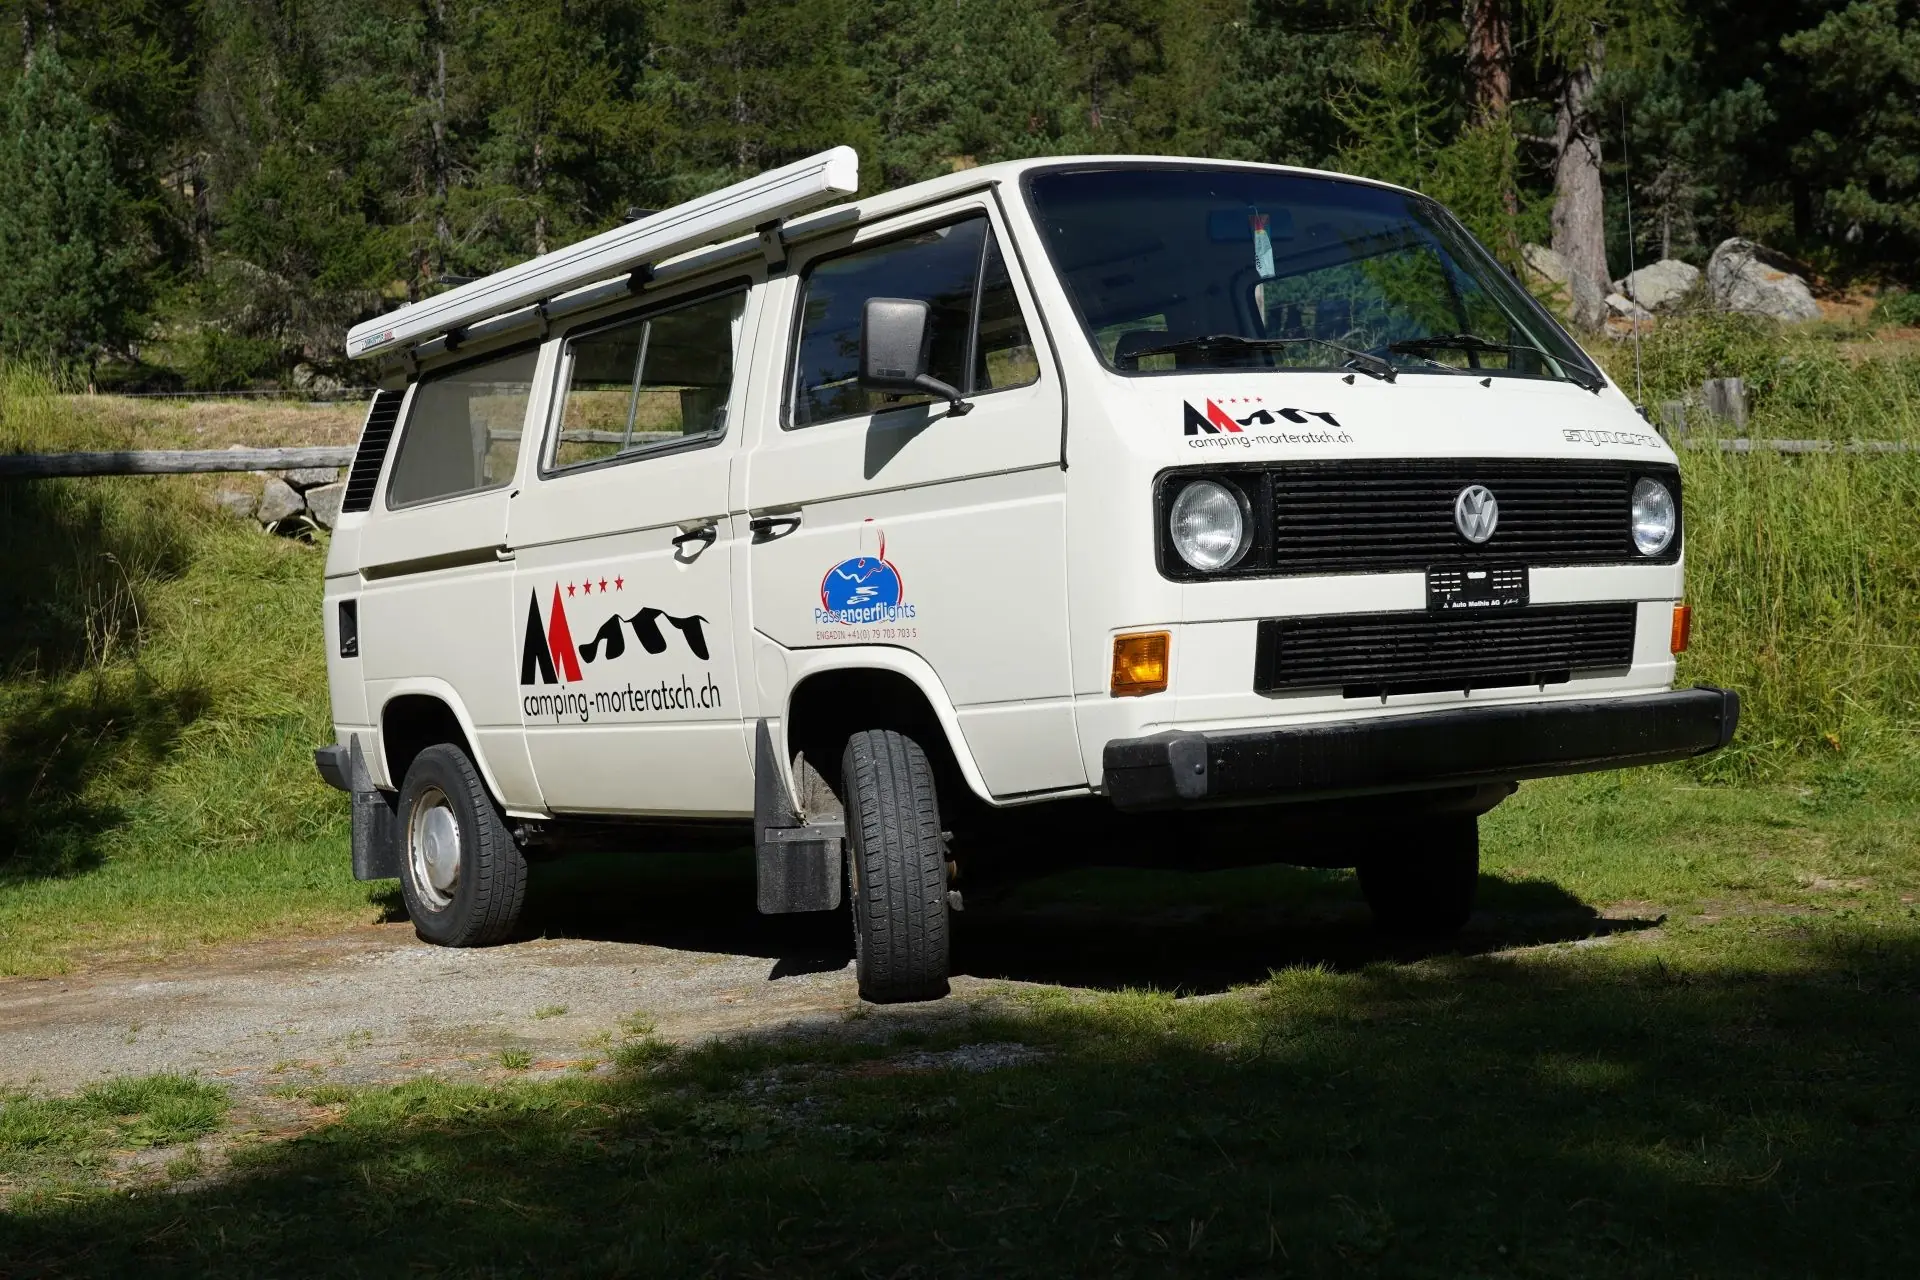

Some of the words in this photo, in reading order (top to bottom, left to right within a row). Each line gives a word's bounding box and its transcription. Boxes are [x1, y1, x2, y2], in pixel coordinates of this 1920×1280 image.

[1188, 431, 1354, 449] camping-morteratsch.ch
[814, 601, 916, 624] Passengerflights
[816, 630, 846, 640] ENGADIN
[872, 629, 881, 639] 79
[883, 629, 895, 639] 703
[897, 628, 910, 638] 703
[523, 671, 722, 723] camping-morteratsch.ch
